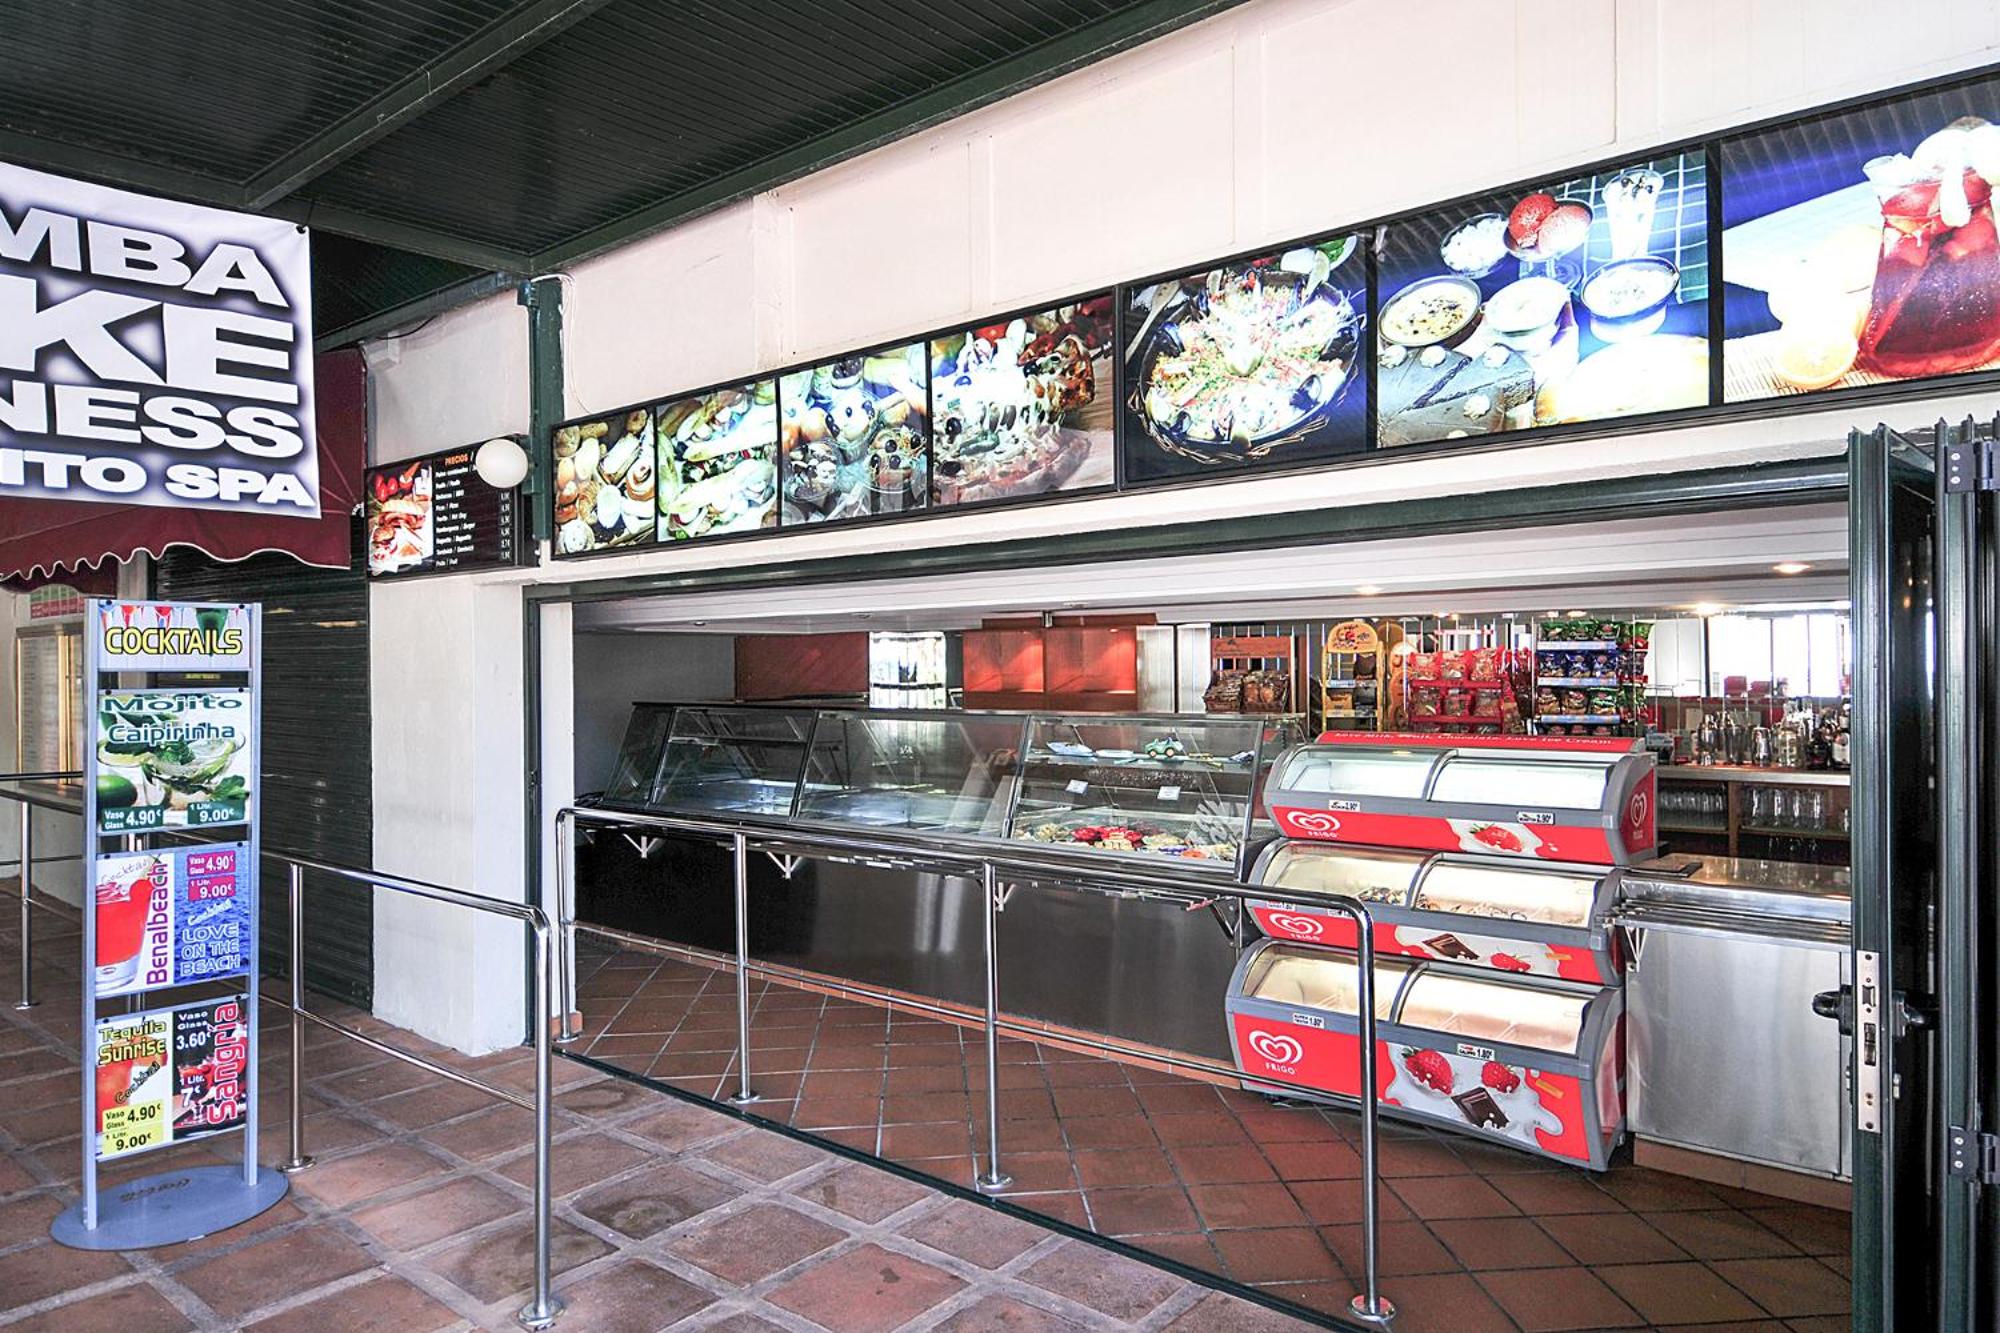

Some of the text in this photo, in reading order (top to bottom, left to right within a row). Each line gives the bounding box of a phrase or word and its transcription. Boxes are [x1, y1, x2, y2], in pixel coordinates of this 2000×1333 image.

[165, 463, 316, 507] SPA
[105, 626, 243, 655] COCKTAILS
[104, 696, 242, 714] Mojito
[108, 723, 235, 746] Caipirinha
[147, 863, 168, 985] Benalbeach
[182, 922, 239, 944] LOVE
[181, 938, 239, 960] ON THE
[180, 954, 240, 977] BEACH
[177, 1021, 209, 1030] Glass
[178, 1011, 208, 1021] Vaso
[99, 1018, 167, 1042] Tequila
[98, 1038, 167, 1065] Sunrise
[206, 1002, 245, 1125] Sangria
[1265, 1062, 1296, 1075] FRIGO
[106, 1111, 125, 1120] Vaso
[106, 1121, 125, 1130] Glass
